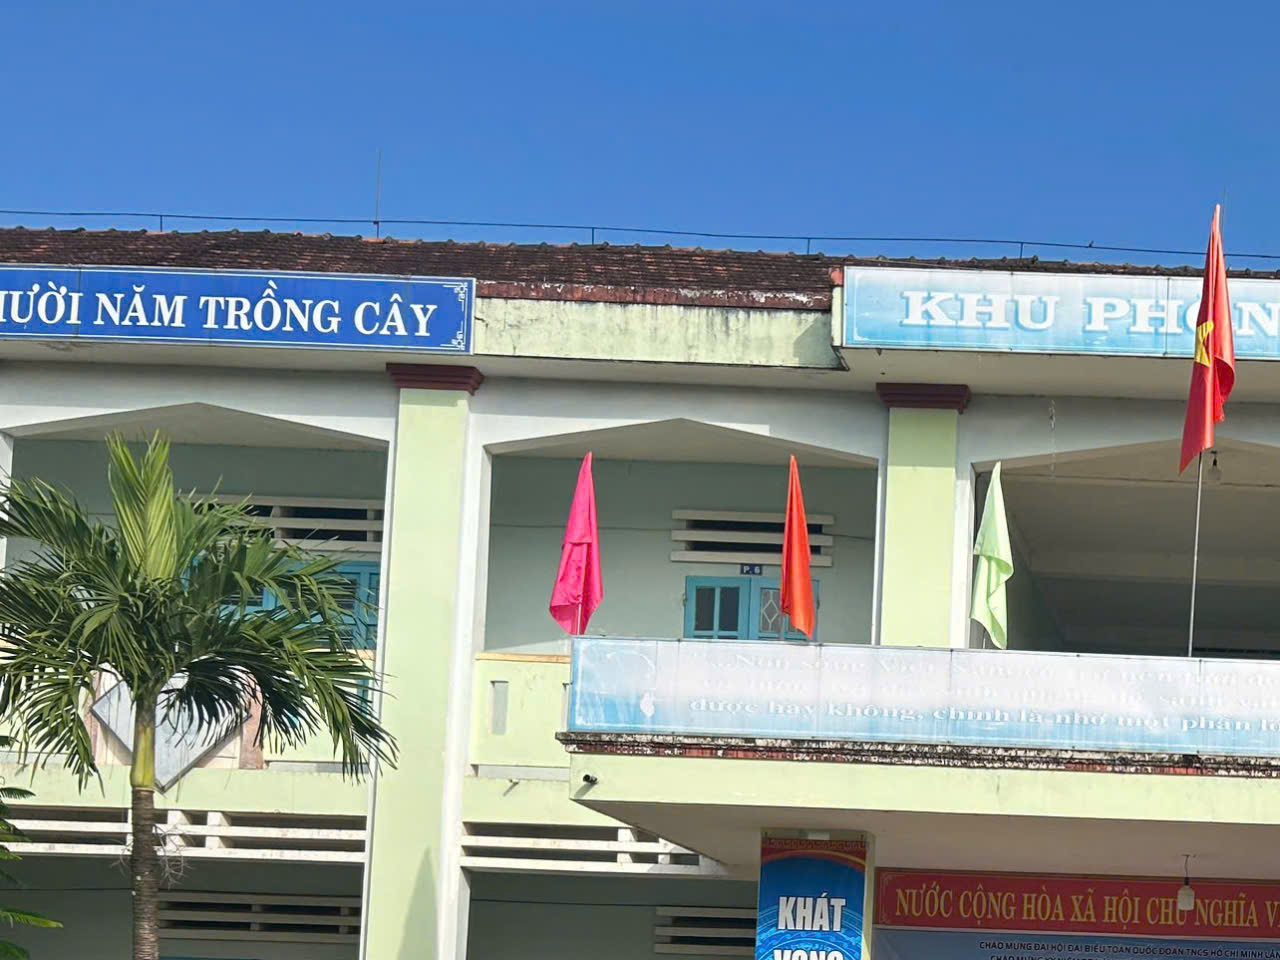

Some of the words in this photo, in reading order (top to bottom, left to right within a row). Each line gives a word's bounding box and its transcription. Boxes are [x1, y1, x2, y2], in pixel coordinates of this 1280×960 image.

[0, 281, 83, 324] ƯỜI
[93, 287, 186, 327] NĂM
[199, 280, 341, 333] TRỒNG
[354, 295, 438, 338] CÂY
[902, 290, 1060, 331] KHU
[777, 892, 846, 932] KHÁT
[895, 882, 952, 918] NƯỚC
[959, 884, 1016, 925] CỘNG
[1022, 885, 1065, 921] HÒA
[1070, 889, 1096, 922] XÃ
[1102, 889, 1140, 930] HỘI
[1194, 893, 1258, 928] NGHĨA
[1186, 948, 1208, 956] TNCS
[1240, 950, 1263, 958] MINH
